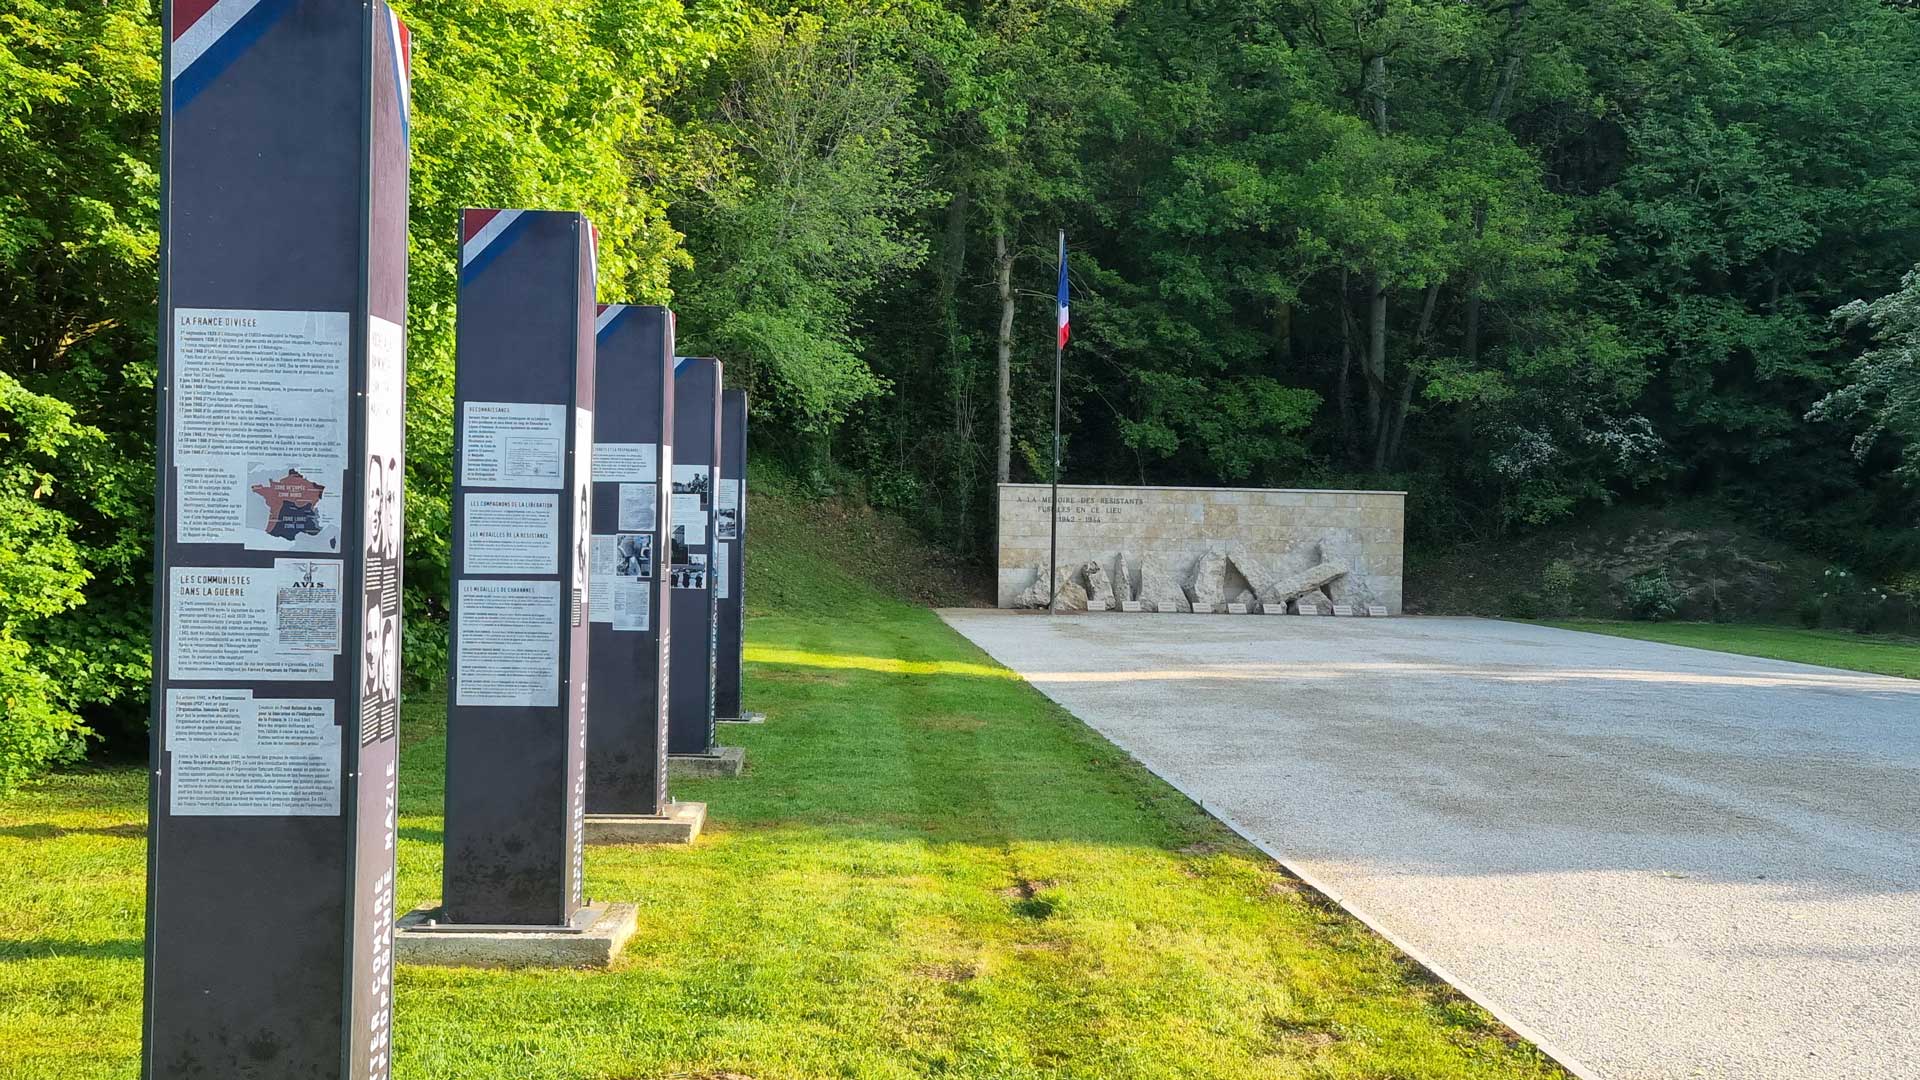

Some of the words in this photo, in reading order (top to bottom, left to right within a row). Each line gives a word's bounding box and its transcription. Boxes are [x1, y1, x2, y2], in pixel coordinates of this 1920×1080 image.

[181, 317, 190, 326] LA
[193, 317, 223, 326] FRANCE
[180, 587, 200, 595] DANS
[203, 587, 213, 596] LA
[215, 588, 245, 596] GUERRE
[181, 575, 195, 584] LES
[197, 576, 250, 585] COMMUNISTES
[384, 759, 395, 850] NAZIE
[372, 875, 384, 995] CONTRE
[379, 867, 392, 1070] PROPAGANDE
